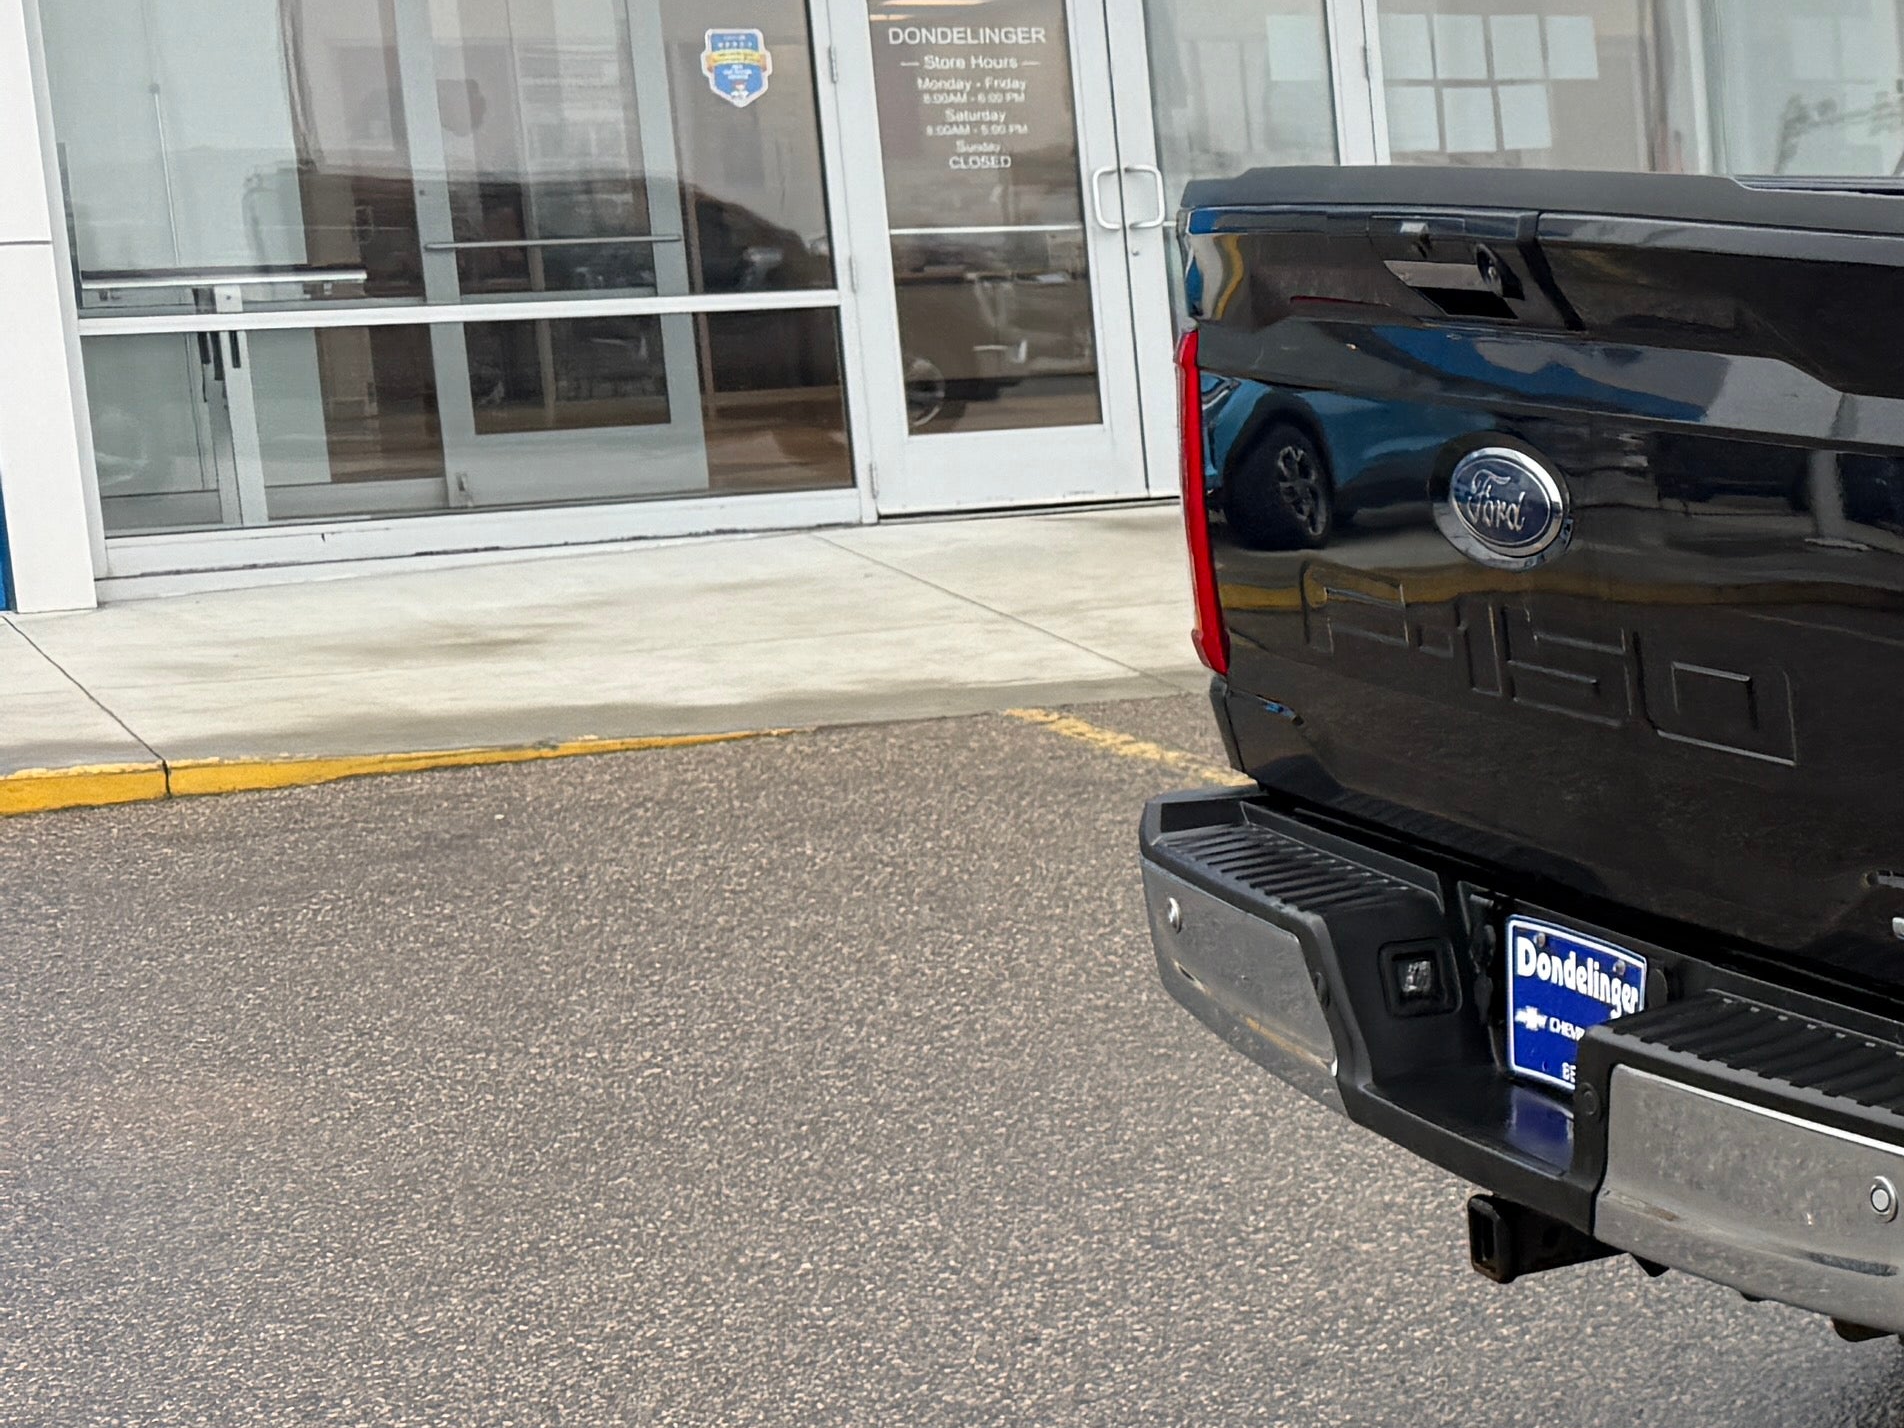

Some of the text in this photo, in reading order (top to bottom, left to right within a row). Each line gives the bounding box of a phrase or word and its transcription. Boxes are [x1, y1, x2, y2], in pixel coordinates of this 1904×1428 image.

[888, 27, 1047, 45] DONDELINGER
[924, 55, 1018, 70] Store Hours
[916, 77, 972, 92] Monday
[985, 76, 1026, 91] Friday
[945, 109, 1006, 123] Saturday
[949, 156, 1012, 170] CLOSED
[1467, 468, 1526, 532] Ford
[1516, 936, 1639, 1020] Dondelinger
